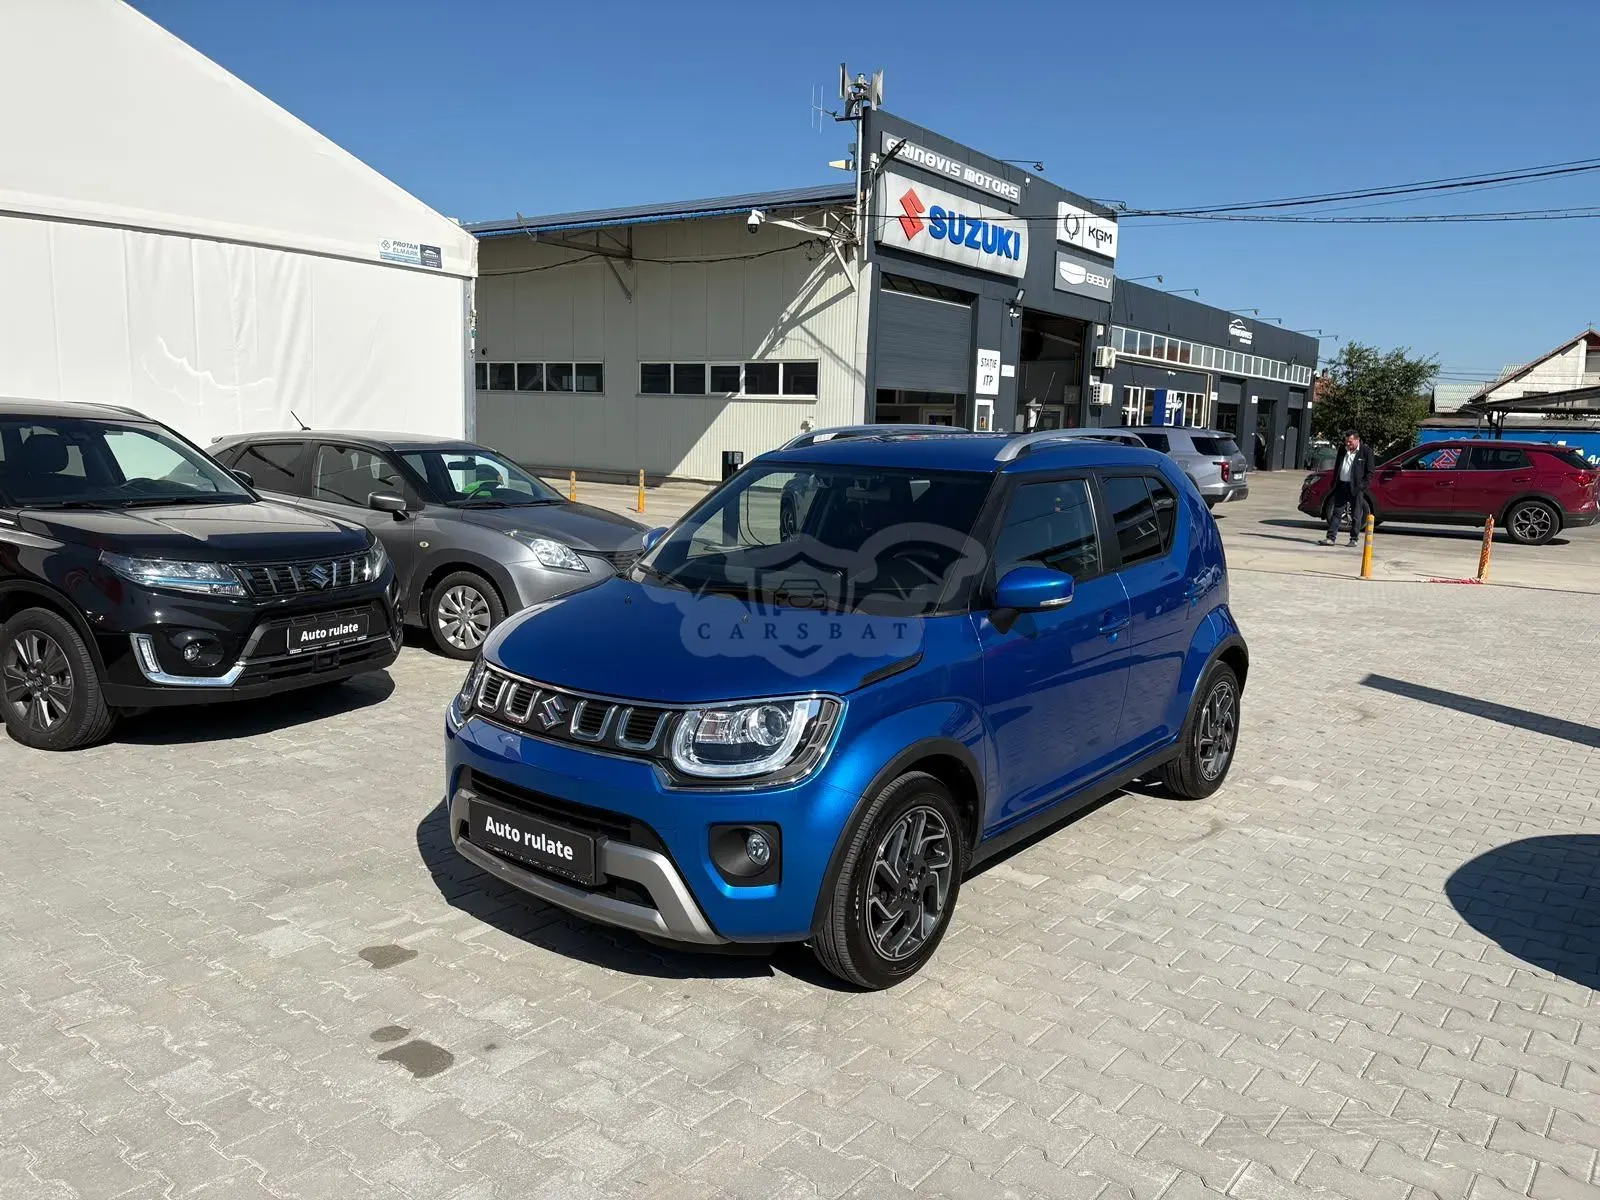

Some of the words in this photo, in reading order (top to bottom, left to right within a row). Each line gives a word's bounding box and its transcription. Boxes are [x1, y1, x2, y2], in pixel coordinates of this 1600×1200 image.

[963, 168, 1019, 199] MOTORS
[928, 205, 1021, 261] SUZUKI
[1088, 226, 1113, 245] KGM
[392, 240, 419, 250] PROTAN
[982, 375, 994, 387] ITP
[300, 629, 327, 642] Auto
[329, 623, 359, 637] rulate
[485, 815, 521, 842] Auto
[524, 831, 573, 861] rulate
